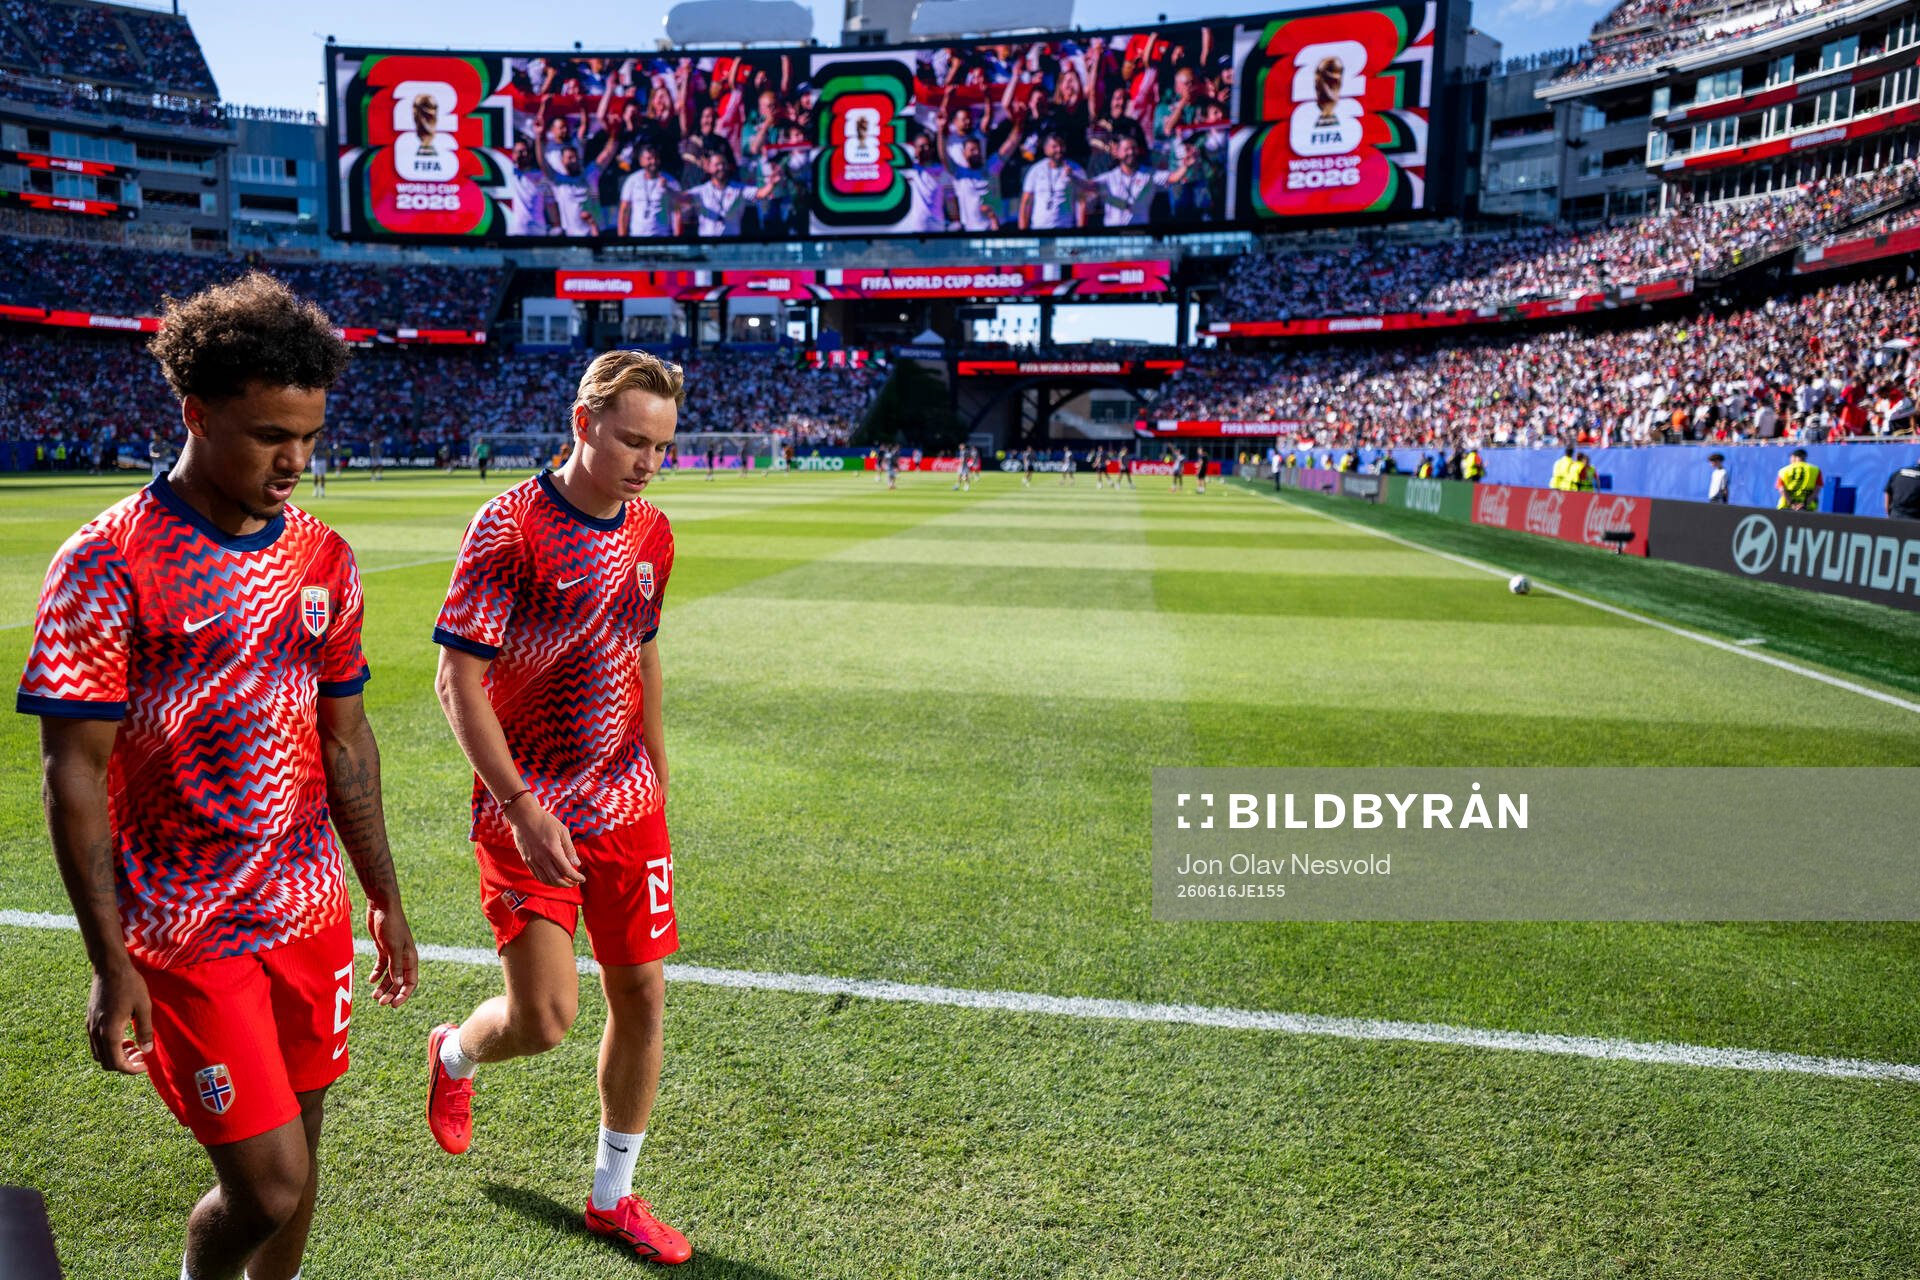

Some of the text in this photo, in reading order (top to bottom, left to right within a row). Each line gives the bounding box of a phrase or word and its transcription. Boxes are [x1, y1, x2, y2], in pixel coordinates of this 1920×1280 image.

[1311, 132, 1342, 144] FIFA
[414, 161, 442, 171] FIFA
[1288, 155, 1361, 171] WORLD CUP
[1287, 168, 1361, 189] 2026
[396, 183, 460, 194] WORLD CUP
[396, 194, 461, 210] 2026
[861, 273, 1024, 290] FIFA WORLD CUP 2026
[1221, 423, 1243, 434] FIFA
[1244, 422, 1278, 434] WORLD
